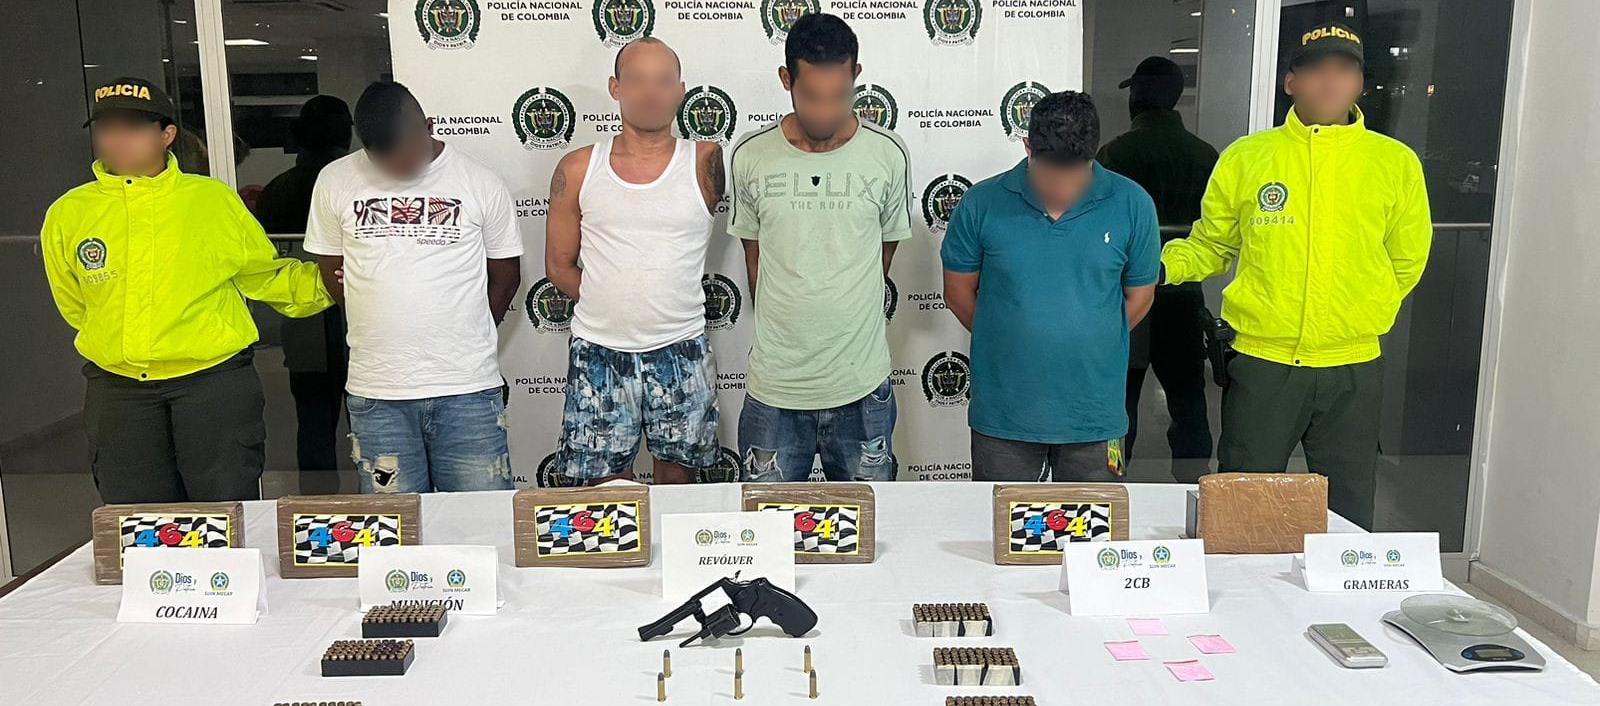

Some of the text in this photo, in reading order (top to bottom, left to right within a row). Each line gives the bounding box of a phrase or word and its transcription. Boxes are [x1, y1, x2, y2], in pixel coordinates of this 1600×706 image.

[487, 0, 582, 10] POLICÍA NACIONAL
[665, 0, 756, 9] POLICÍA NACIONAL
[831, 0, 918, 9] POLICÍA NACIONAL
[501, 12, 570, 21] DE COLOMBIA
[678, 12, 743, 20] DE COLOMBIA
[843, 12, 906, 20] DE COLOMBIA
[1018, 10, 1065, 18] COLOMBIA
[1302, 26, 1360, 46] POLICIA
[95, 84, 151, 103] POLICIA
[583, 112, 621, 122] POLICÍA
[908, 108, 994, 118] POLICÍA NACIONAL
[449, 115, 503, 124] NACIONAL
[934, 120, 982, 128] COLOMBIA
[437, 127, 490, 135] COLOMBIA
[596, 124, 609, 132] DE
[515, 197, 541, 207] LICÍA
[790, 200, 853, 210] THE ROOF
[516, 209, 529, 217] DE
[907, 292, 942, 301] POLICÍA
[515, 375, 552, 385] POLICÍA
[542, 386, 567, 394] COLO
[908, 462, 971, 472] POLICÍA NACIO
[932, 472, 971, 480] COLOMBI
[549, 511, 616, 538] 464
[794, 511, 836, 539] 64
[1023, 509, 1088, 537] 464
[134, 522, 204, 548] 464
[307, 520, 377, 548] 464
[698, 553, 754, 566] REVÓLVER
[1121, 549, 1138, 560] Dios
[175, 572, 192, 585] Dios
[410, 571, 428, 582] Dios
[1124, 577, 1151, 589] 2CB
[1343, 579, 1410, 590] GRAMERAS
[155, 605, 218, 619] COCAINA
